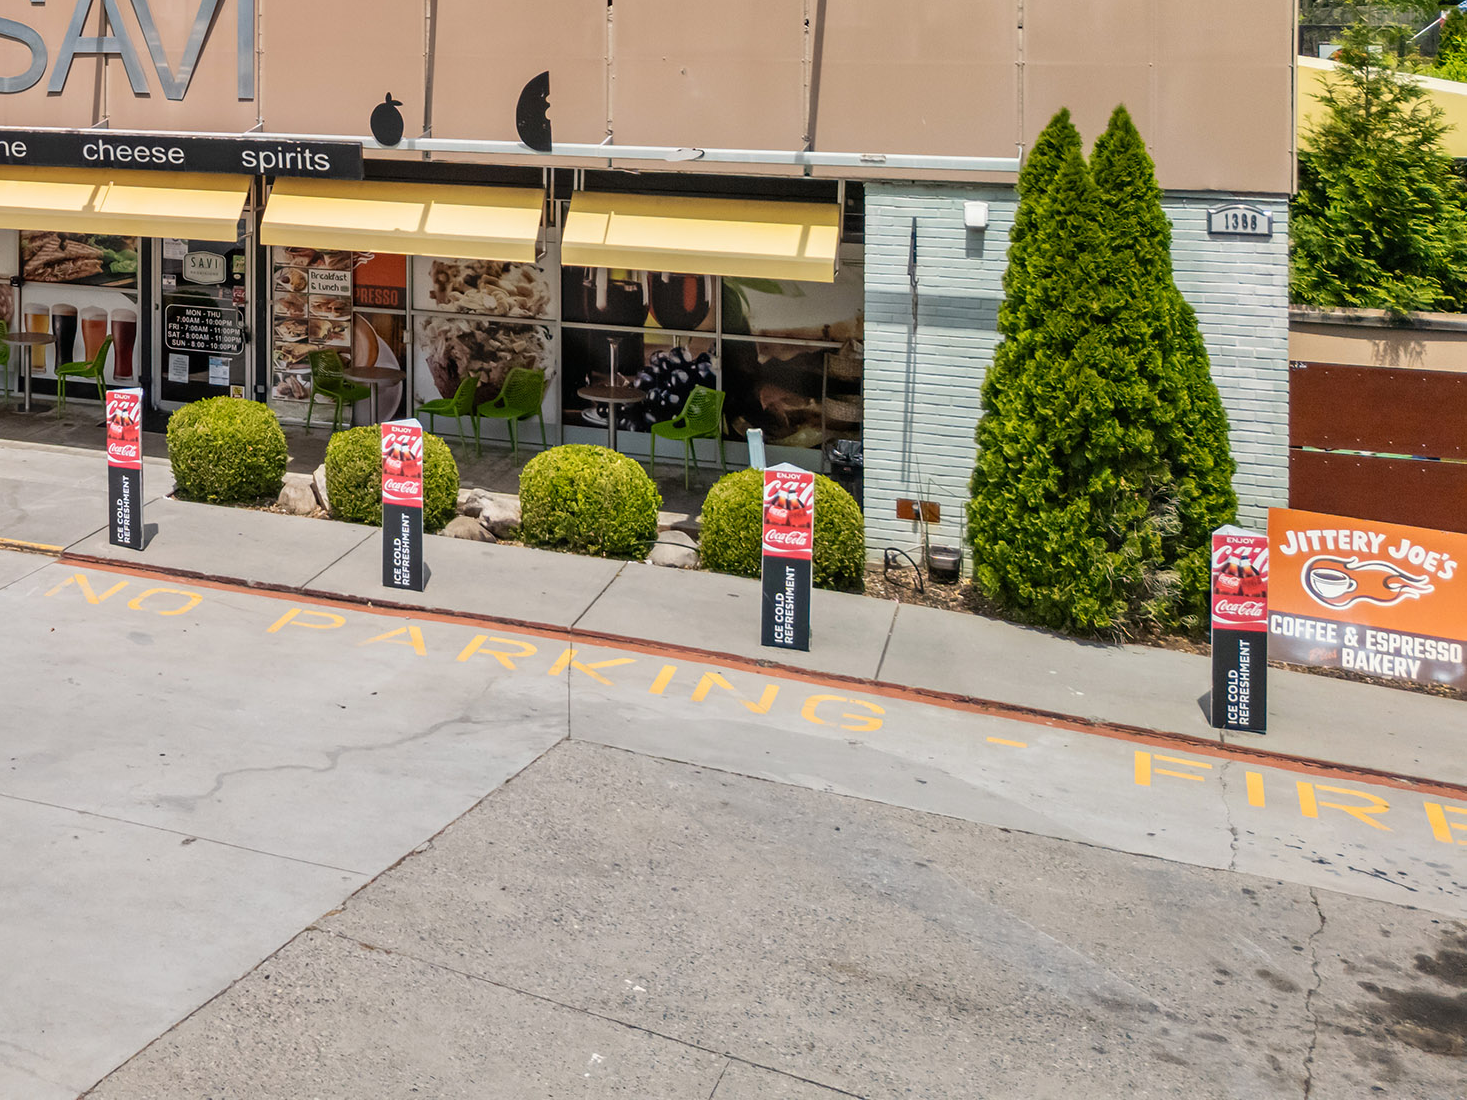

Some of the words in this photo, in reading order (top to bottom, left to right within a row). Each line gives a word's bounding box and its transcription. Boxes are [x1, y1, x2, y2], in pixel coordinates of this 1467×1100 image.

[82, 139, 185, 165] cheese
[240, 147, 331, 174] spirits
[1225, 213, 1257, 231] 1388
[190, 256, 219, 269] SAVI
[310, 271, 347, 281] Breakfast
[311, 282, 316, 290] &
[318, 283, 339, 292] Lunch
[176, 316, 200, 324] 7:00AM
[205, 318, 233, 326] 10:00PM
[207, 310, 221, 318] THU
[167, 331, 180, 339] SAT
[185, 332, 210, 341] 8:00AM
[215, 335, 242, 343] 11:00PM
[185, 324, 209, 332] 7:00AM
[214, 327, 241, 335] 11:00PM
[171, 339, 186, 347] SUN
[210, 343, 237, 351] 10:00PM
[391, 426, 412, 434] ENJOY
[776, 472, 801, 480] ENJOY
[122, 475, 131, 544] REFRESHMENT
[401, 512, 410, 586] REFRESHMENT
[1226, 536, 1255, 544] ENJOY
[393, 537, 402, 566] COLD
[1279, 529, 1386, 556] JITTERY
[1387, 538, 1458, 580] JOE'S
[393, 568, 401, 585] ICE
[775, 592, 784, 624] COLD
[784, 565, 796, 645] REFRESHMENT
[774, 625, 783, 643] ICE
[1270, 614, 1338, 644] COFFEE
[1344, 626, 1359, 649] &
[1365, 629, 1463, 664] ESPRESSO
[44, 574, 203, 616] NO
[267, 608, 887, 732] PARKING
[1341, 647, 1422, 679] BAKERY
[1227, 669, 1238, 704] COLD
[1238, 639, 1251, 726] REFRESHMENT
[1227, 705, 1238, 725] ICE
